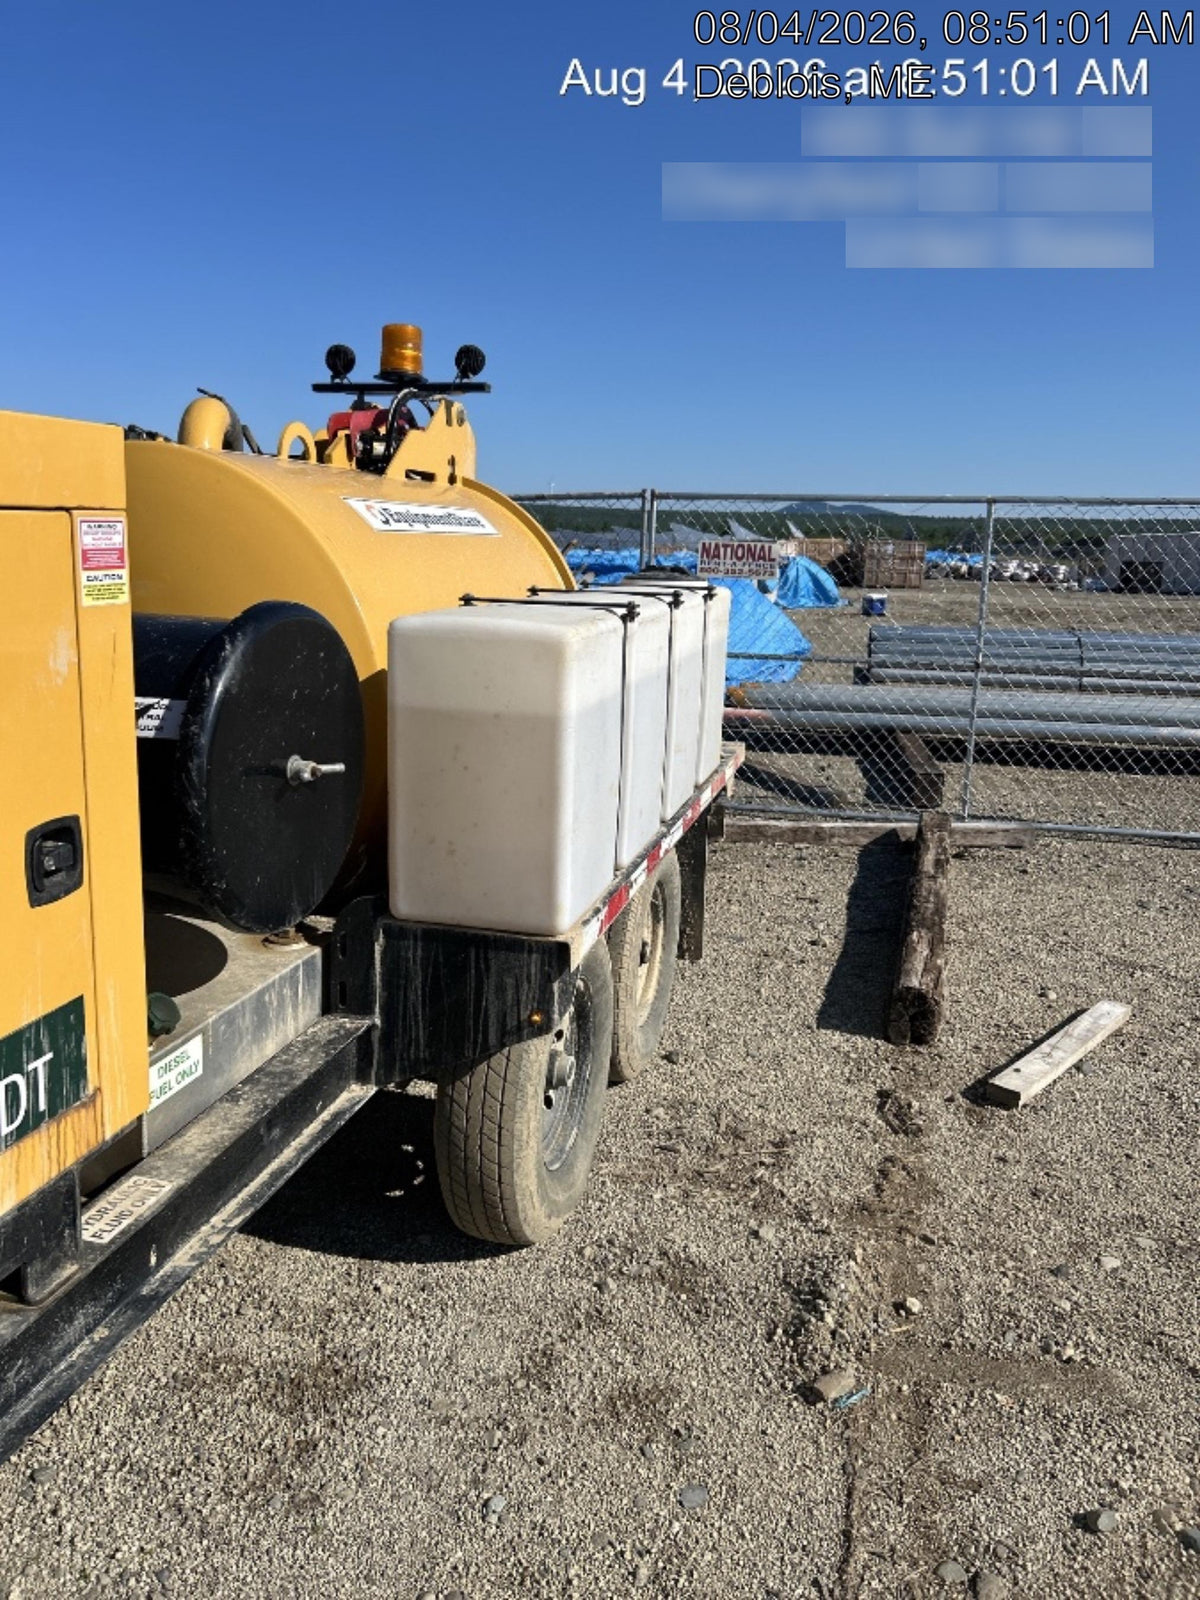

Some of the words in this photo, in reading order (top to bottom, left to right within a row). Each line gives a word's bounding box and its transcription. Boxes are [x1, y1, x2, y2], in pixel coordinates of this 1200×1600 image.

[701, 542, 776, 562] NATIONAL
[86, 573, 123, 582] CAUTION
[157, 1050, 191, 1080] DIESEL
[149, 1079, 175, 1100] FUEL
[175, 1058, 200, 1085] ONLY
